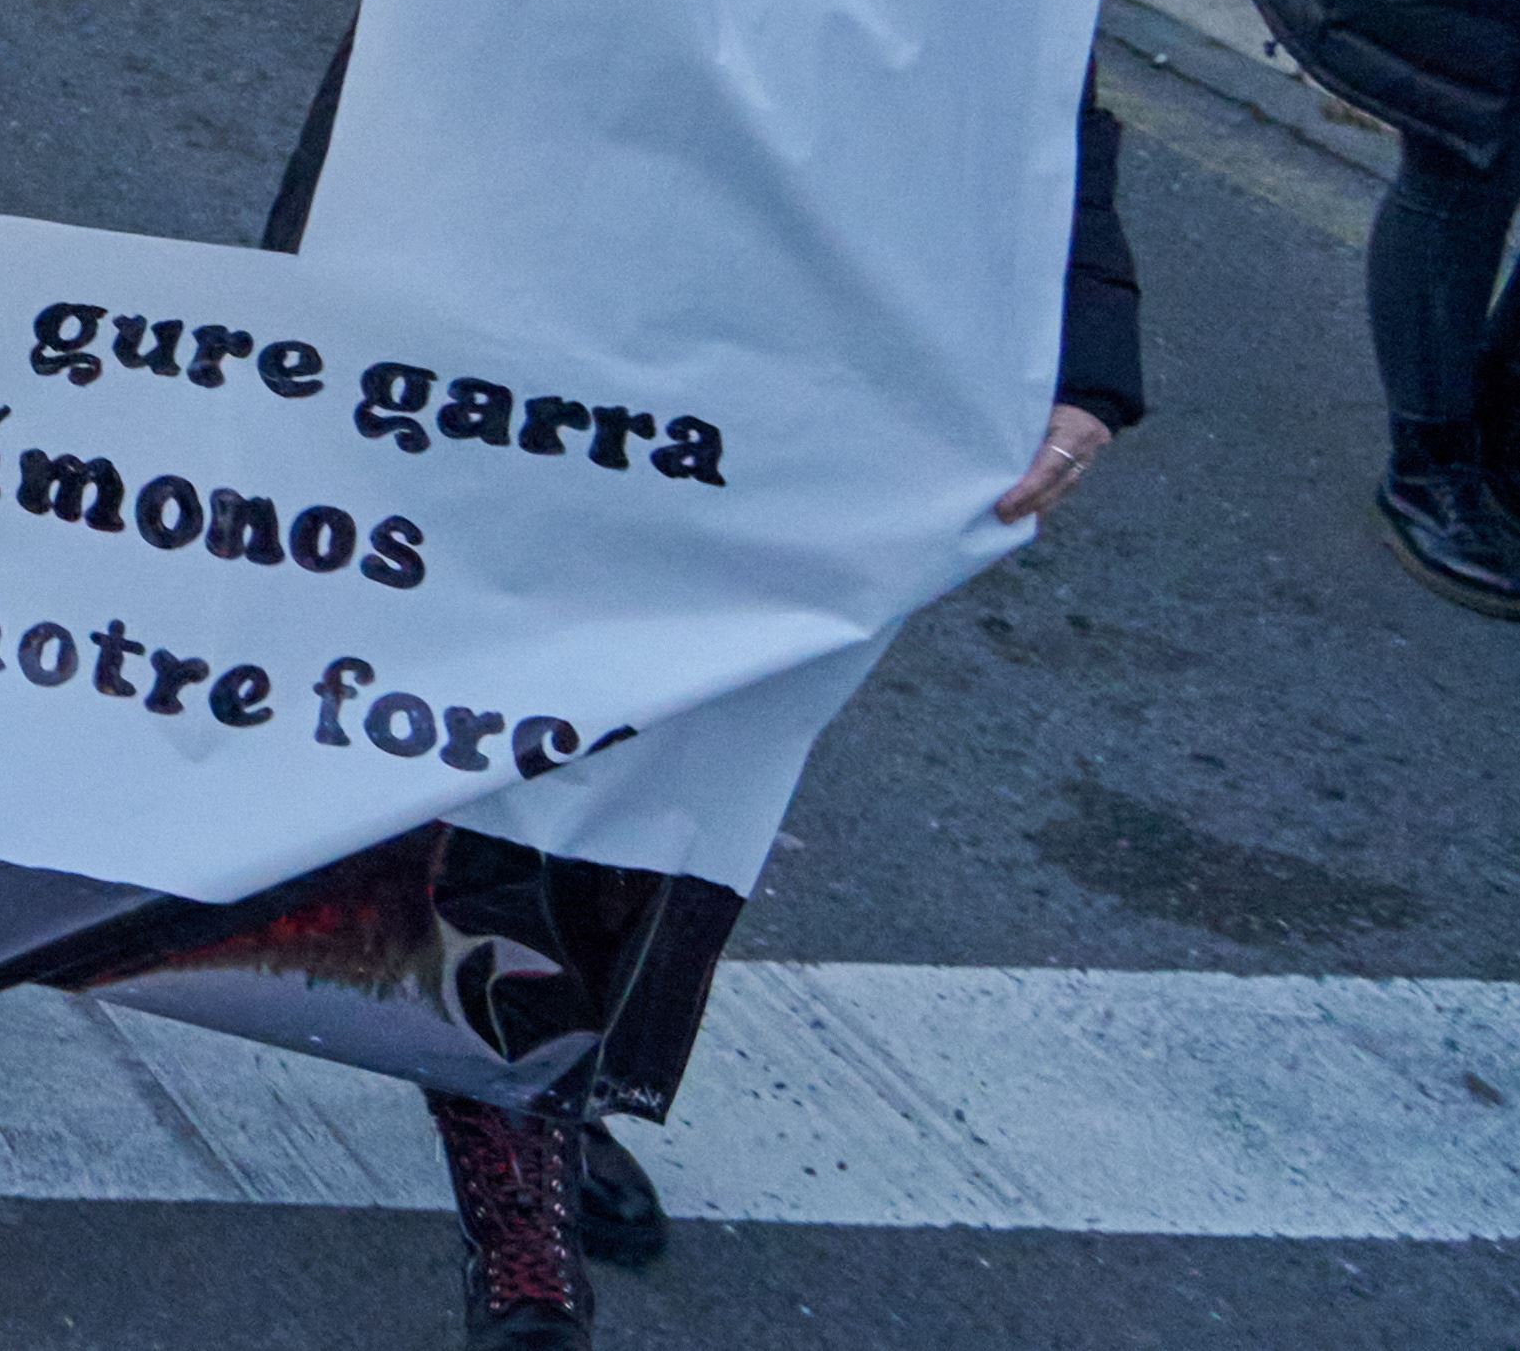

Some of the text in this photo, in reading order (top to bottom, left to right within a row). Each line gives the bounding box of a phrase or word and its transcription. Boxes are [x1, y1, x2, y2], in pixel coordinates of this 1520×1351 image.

[30, 303, 323, 398] gure
[354, 362, 726, 487] garra
[314, 657, 639, 782] forc
